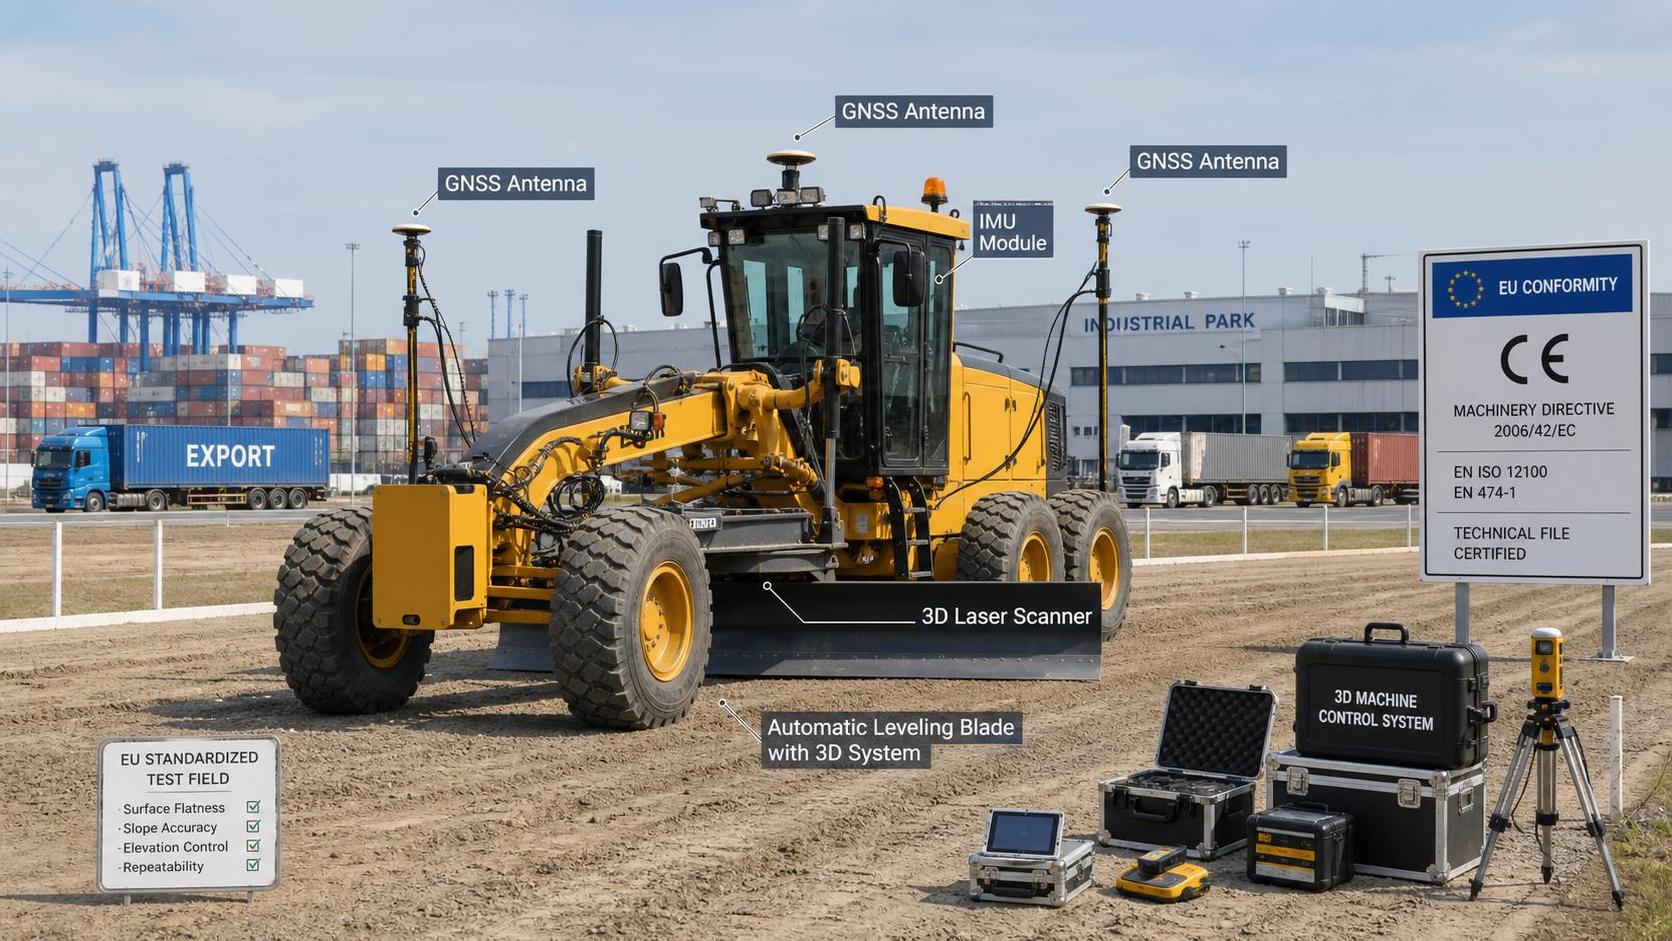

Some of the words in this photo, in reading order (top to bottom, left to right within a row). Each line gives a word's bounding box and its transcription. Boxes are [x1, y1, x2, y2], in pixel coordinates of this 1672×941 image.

[1499, 280, 1518, 296] EU
[1522, 276, 1618, 295] CONFORMITY
[1084, 315, 1195, 333] INDUSTRIAL
[1205, 312, 1255, 329] PARK
[1500, 333, 1569, 385] CE
[1454, 403, 1537, 418] MACHINERY
[1541, 401, 1615, 417] DIRECTIVE
[1494, 423, 1576, 439] 2006/42/EC
[186, 443, 276, 468] EXPORT
[1454, 465, 1473, 479] EN
[1478, 465, 1502, 479] ISO
[1507, 464, 1548, 479] 12100
[1454, 485, 1473, 499] EN
[1477, 486, 1516, 499] 474-1
[1453, 526, 1536, 540] TECHNICAL
[1540, 526, 1570, 540] FILE
[1454, 546, 1527, 561] CERTIFIED
[1334, 689, 1352, 704] 3D
[1355, 690, 1418, 709] MACHINE
[1318, 709, 1379, 727] CONTROL
[1382, 713, 1434, 731] SYSTEM
[121, 753, 140, 766] EU
[145, 751, 259, 766] STANDARDIZED
[147, 773, 184, 786] TEST
[188, 772, 230, 785] FIELD
[123, 803, 171, 815] Surface
[174, 802, 225, 814] Flatness
[123, 822, 158, 835] Slope
[161, 822, 217, 835] Accuracy
[123, 841, 180, 854] Elevation
[183, 840, 228, 853] Control
[123, 861, 204, 875] Repeatability
